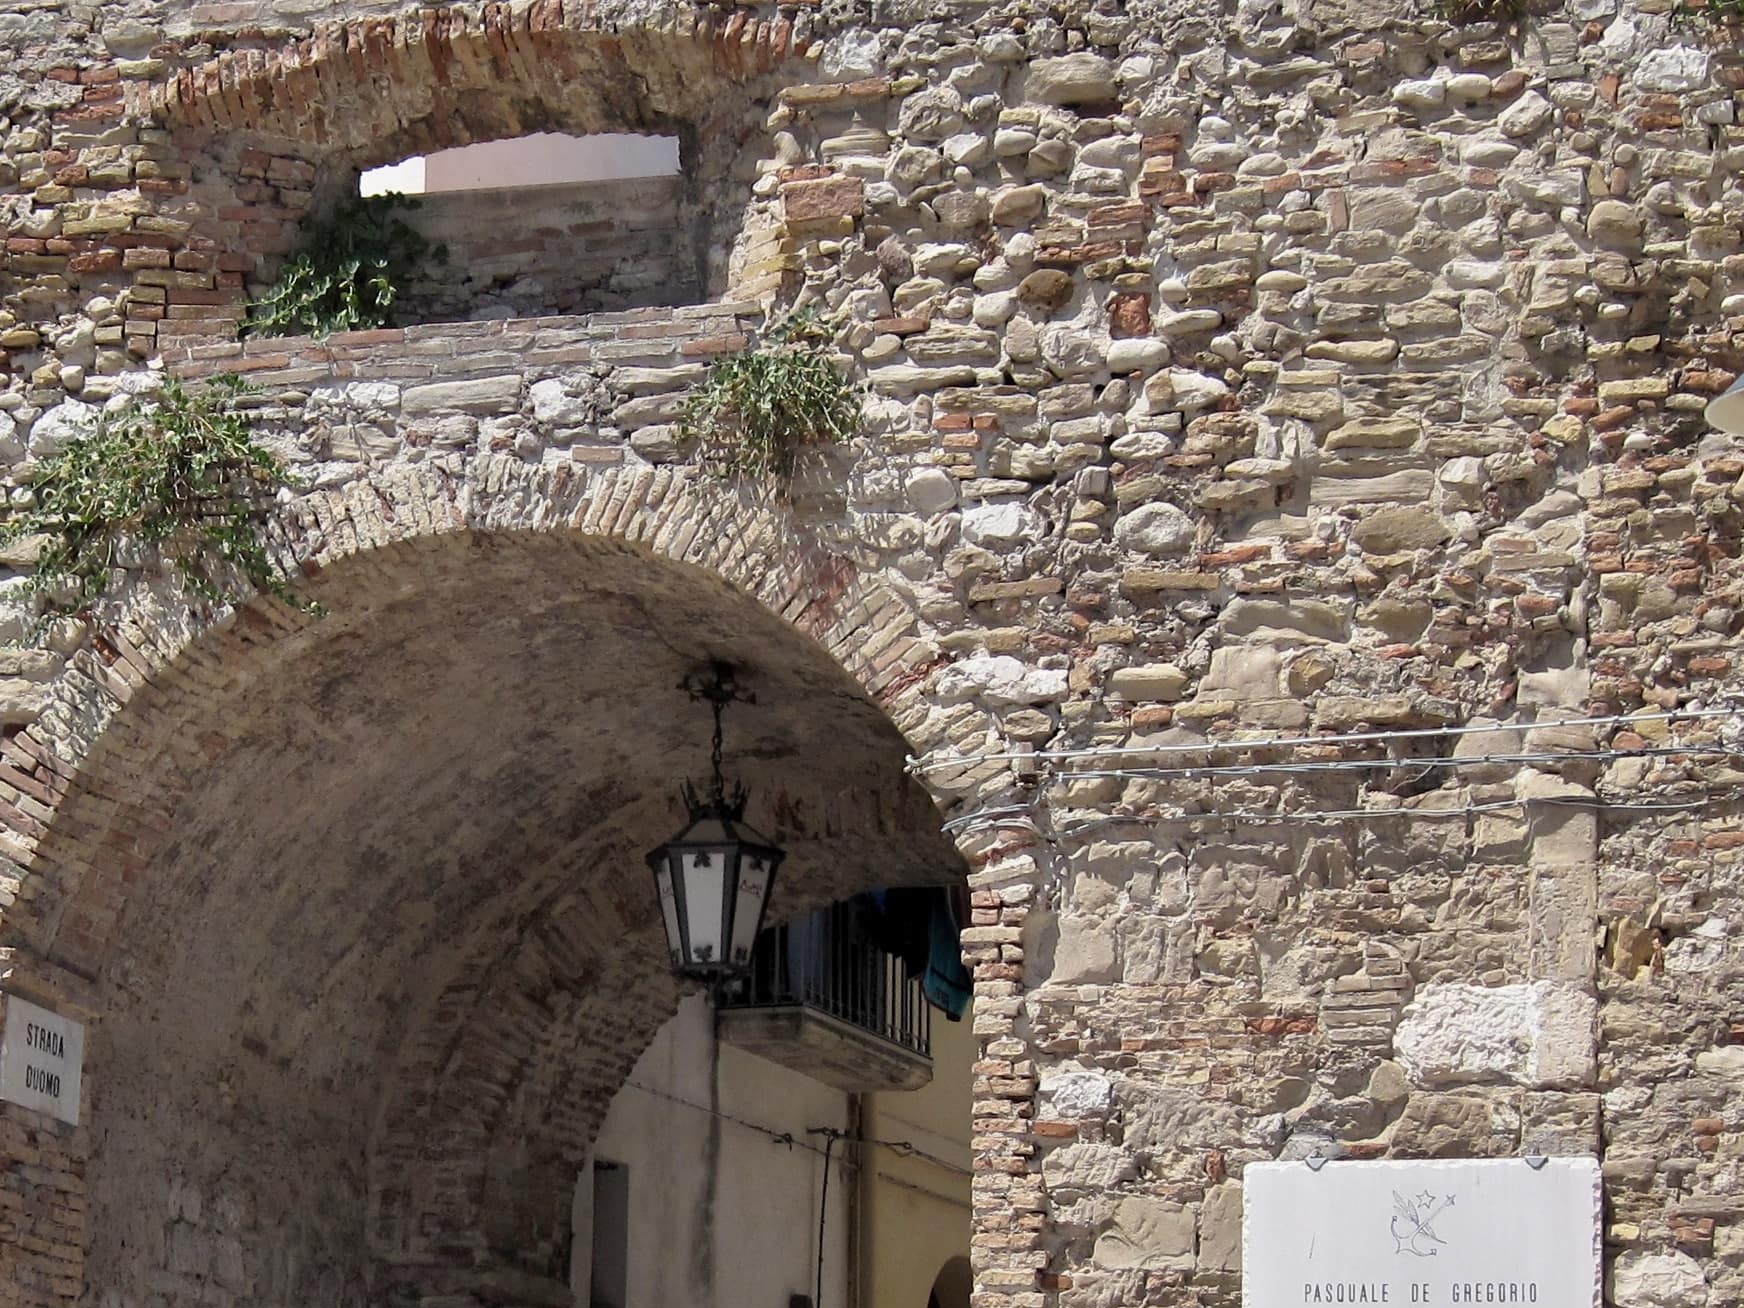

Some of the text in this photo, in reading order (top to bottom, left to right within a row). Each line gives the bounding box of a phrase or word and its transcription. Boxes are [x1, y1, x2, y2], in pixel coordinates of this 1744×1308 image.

[26, 1022, 64, 1059] STRADA
[26, 1065, 60, 1098] DUOMO
[1305, 1283, 1538, 1302] PASQUALE DE GREGORIO
